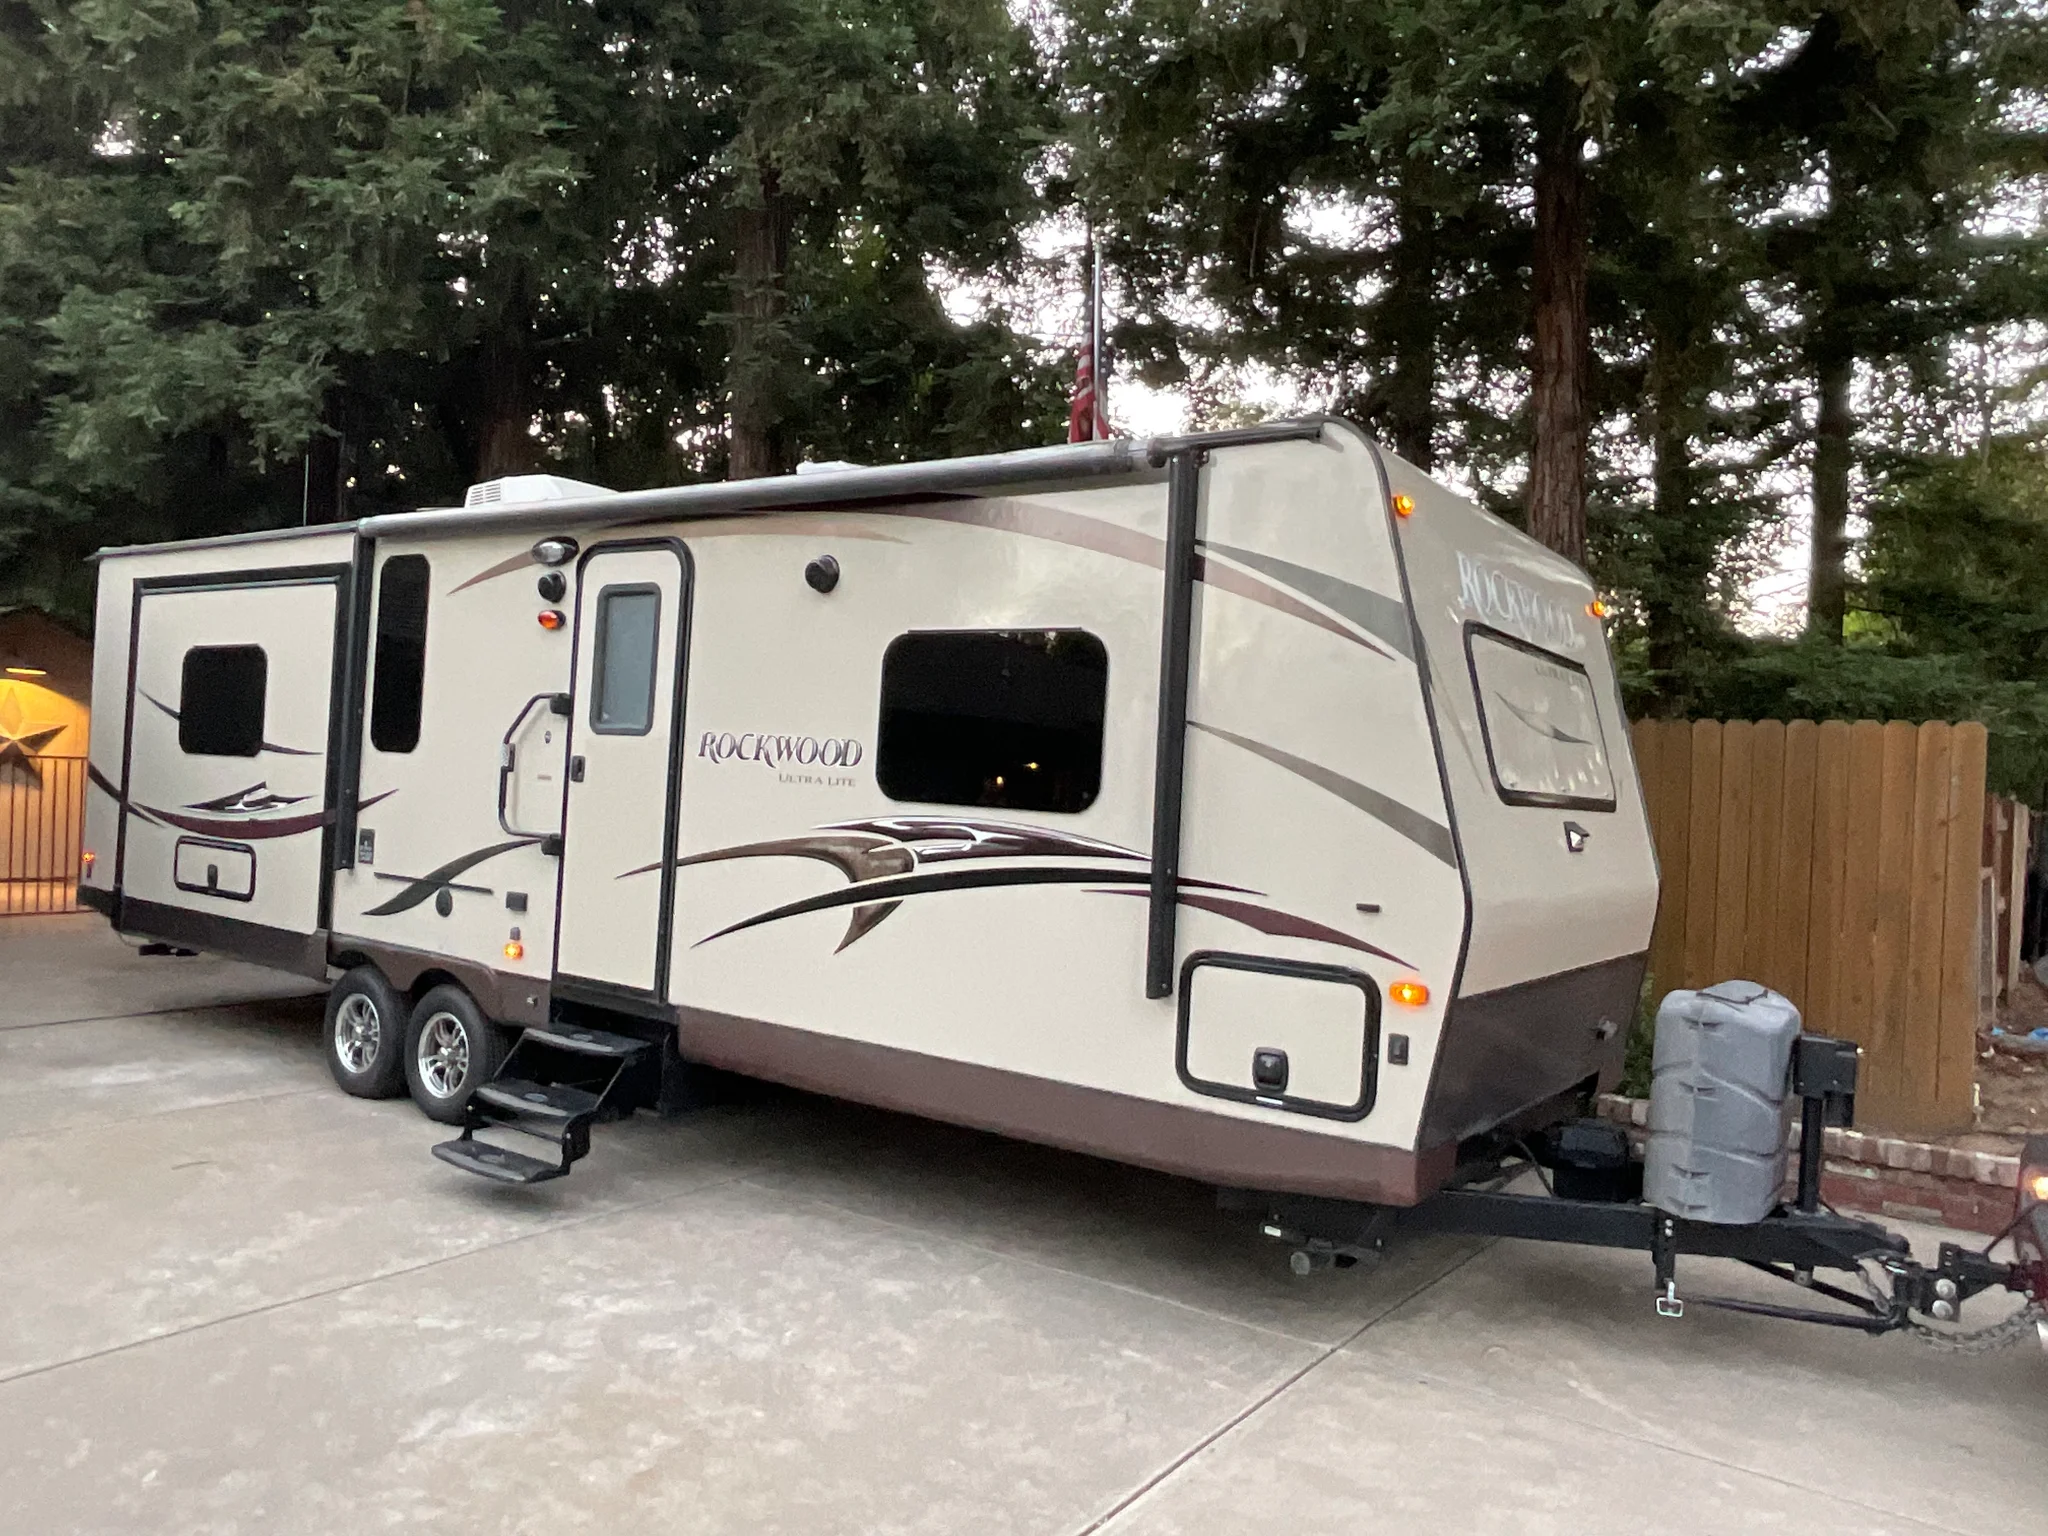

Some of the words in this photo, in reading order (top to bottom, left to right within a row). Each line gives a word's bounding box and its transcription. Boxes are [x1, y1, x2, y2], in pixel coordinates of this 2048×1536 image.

[698, 731, 862, 768] ROCKWOOD
[779, 773, 823, 786] ULTRA
[828, 776, 856, 788] LITE
